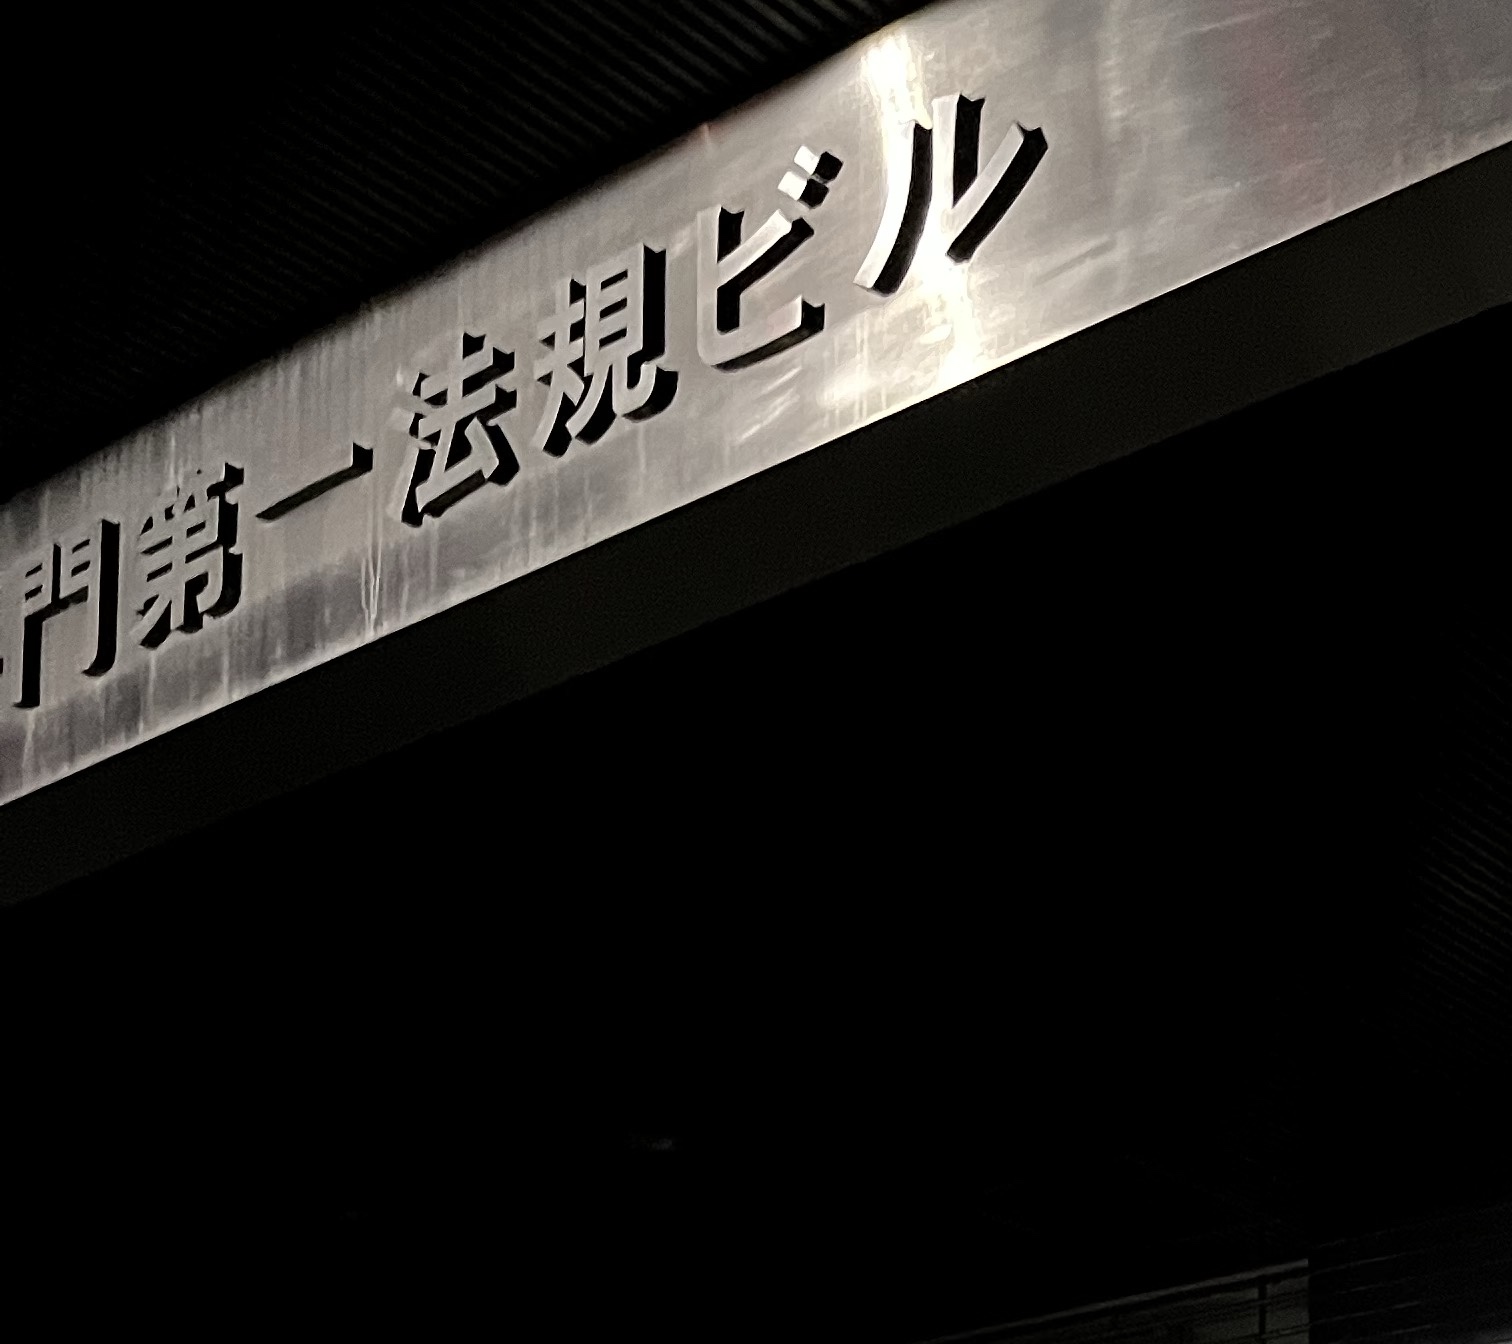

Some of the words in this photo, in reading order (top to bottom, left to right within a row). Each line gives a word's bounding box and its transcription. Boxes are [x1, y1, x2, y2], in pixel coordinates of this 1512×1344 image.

[0, 90, 1049, 710] 門第一法規ビル
